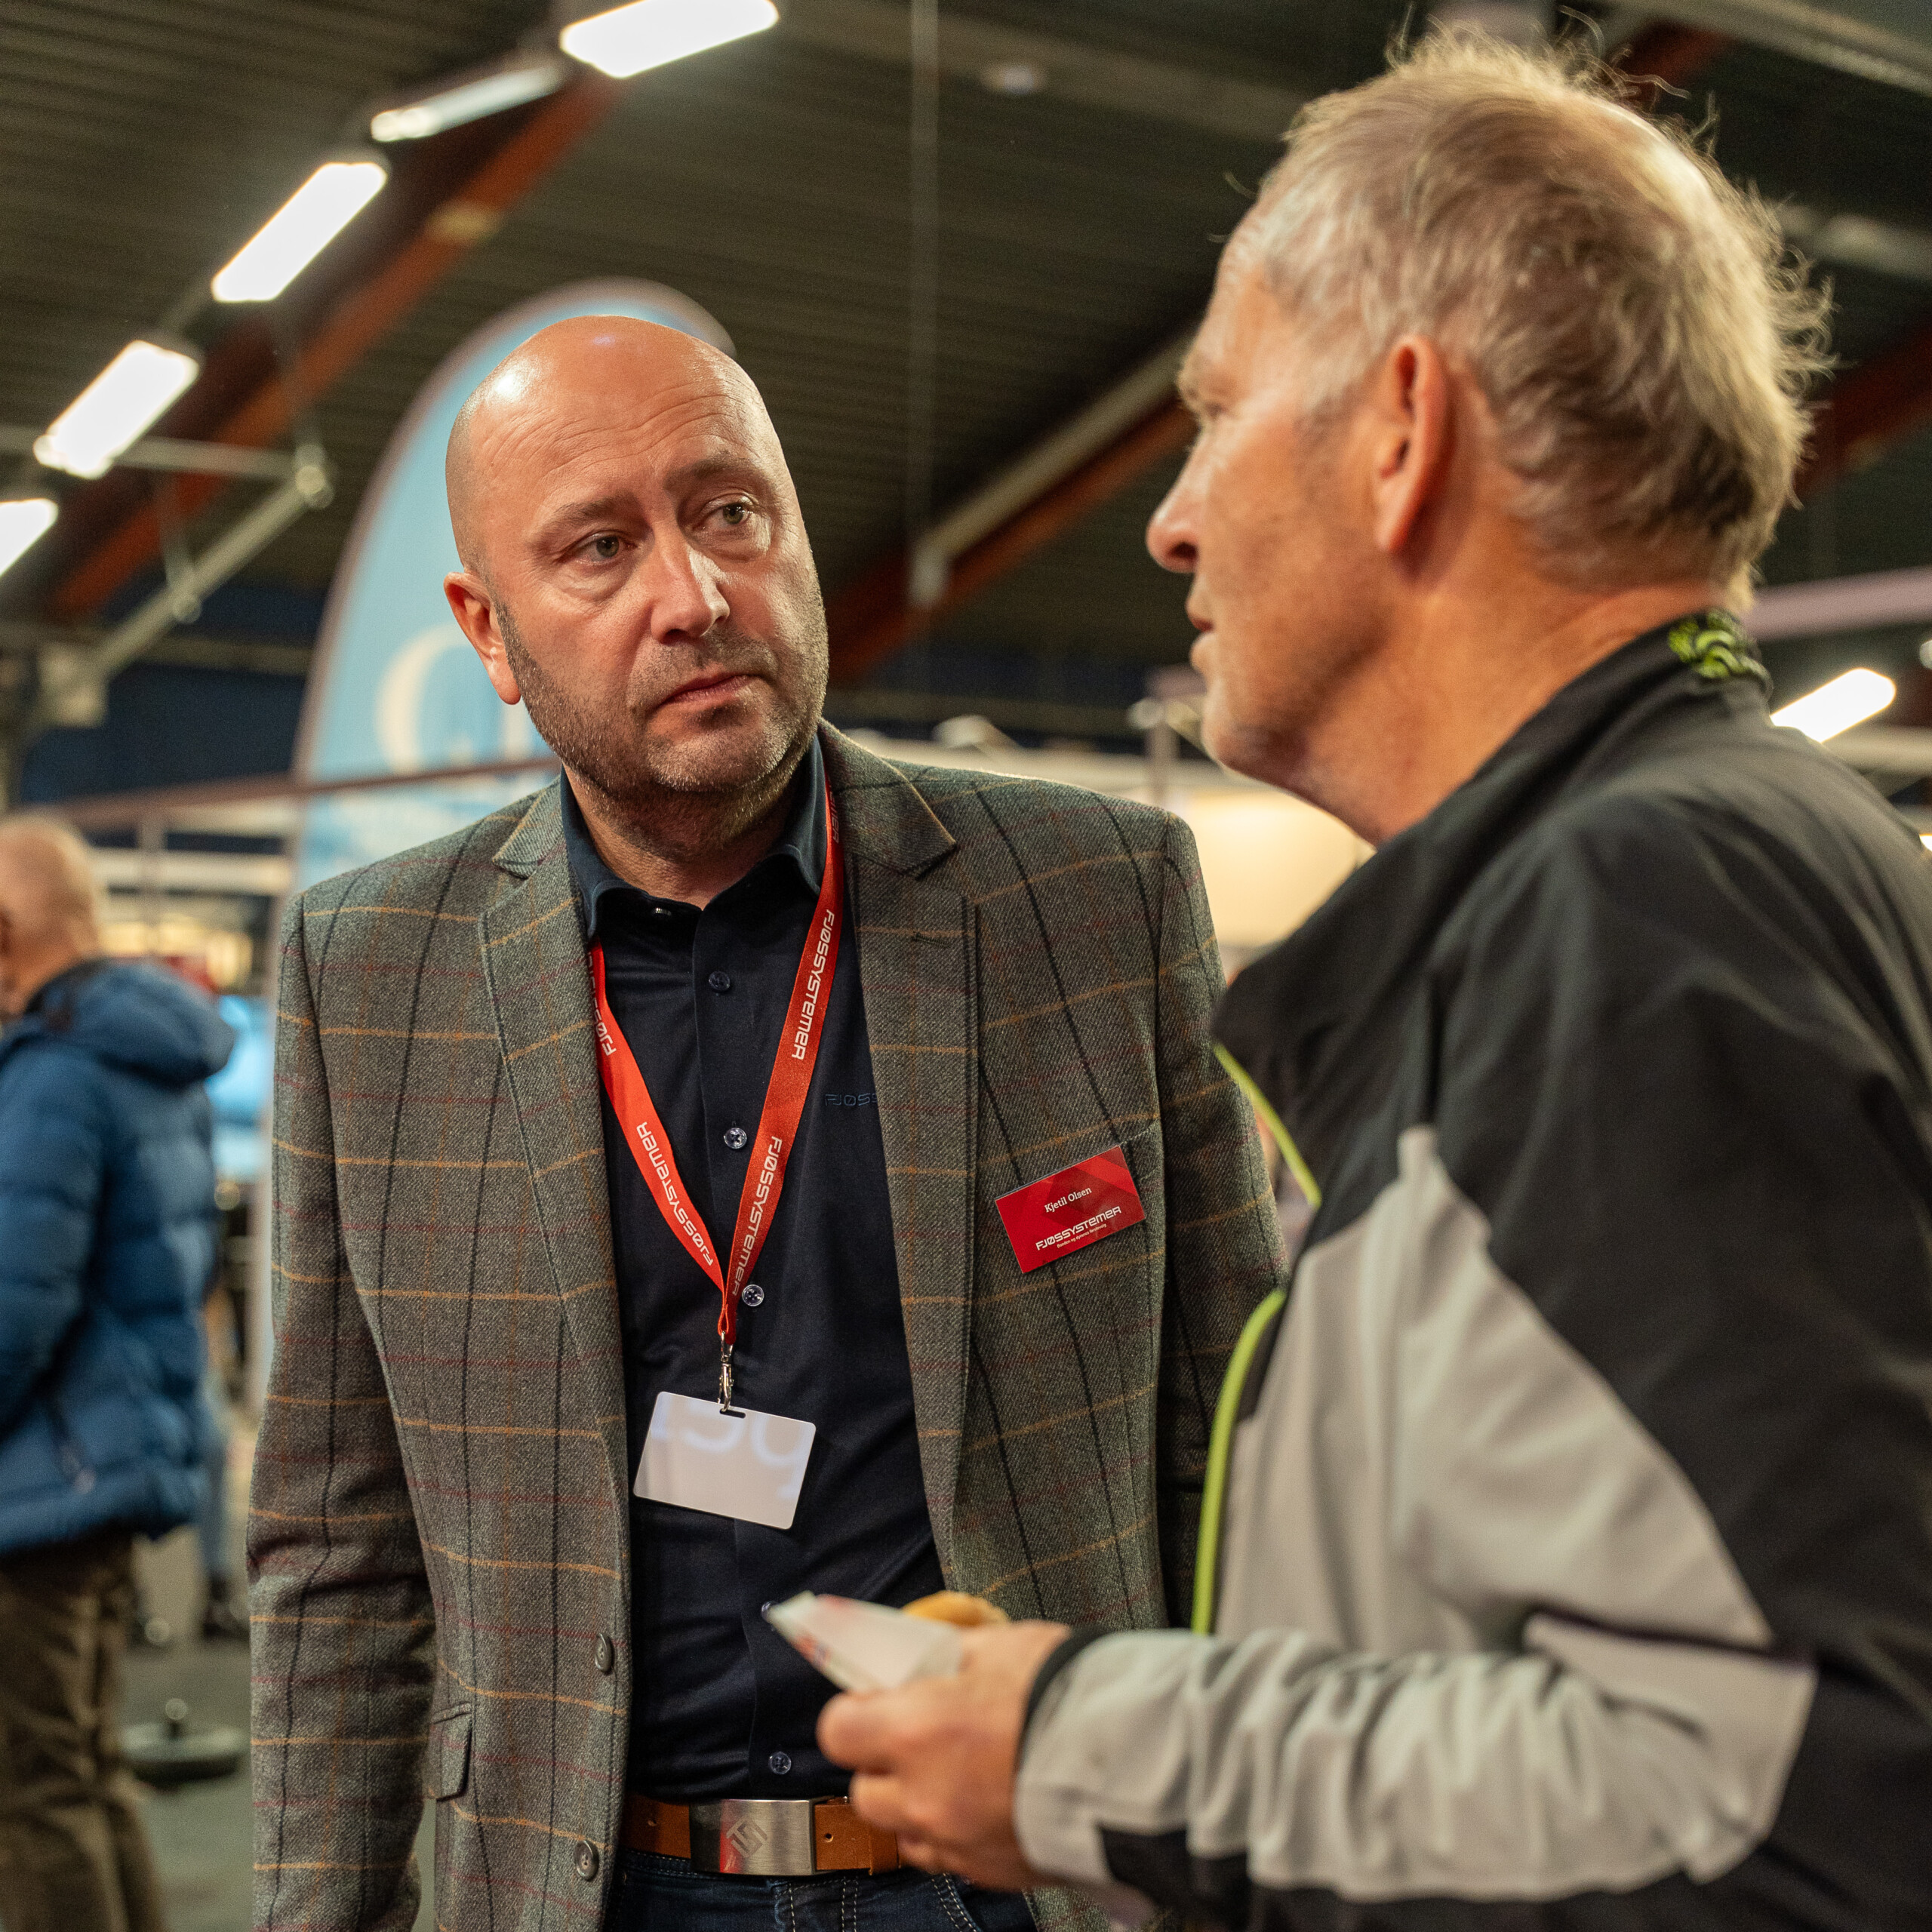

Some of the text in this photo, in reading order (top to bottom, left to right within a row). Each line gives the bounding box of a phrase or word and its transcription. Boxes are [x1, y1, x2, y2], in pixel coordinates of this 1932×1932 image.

[792, 909, 835, 1060] FJØSSYSTEMER
[636, 1121, 713, 1266] FJØSSYSTEMER
[1035, 1206, 1121, 1251] FJØSSYSTEMER
[1044, 1187, 1092, 1213] Kjetil Olsen
